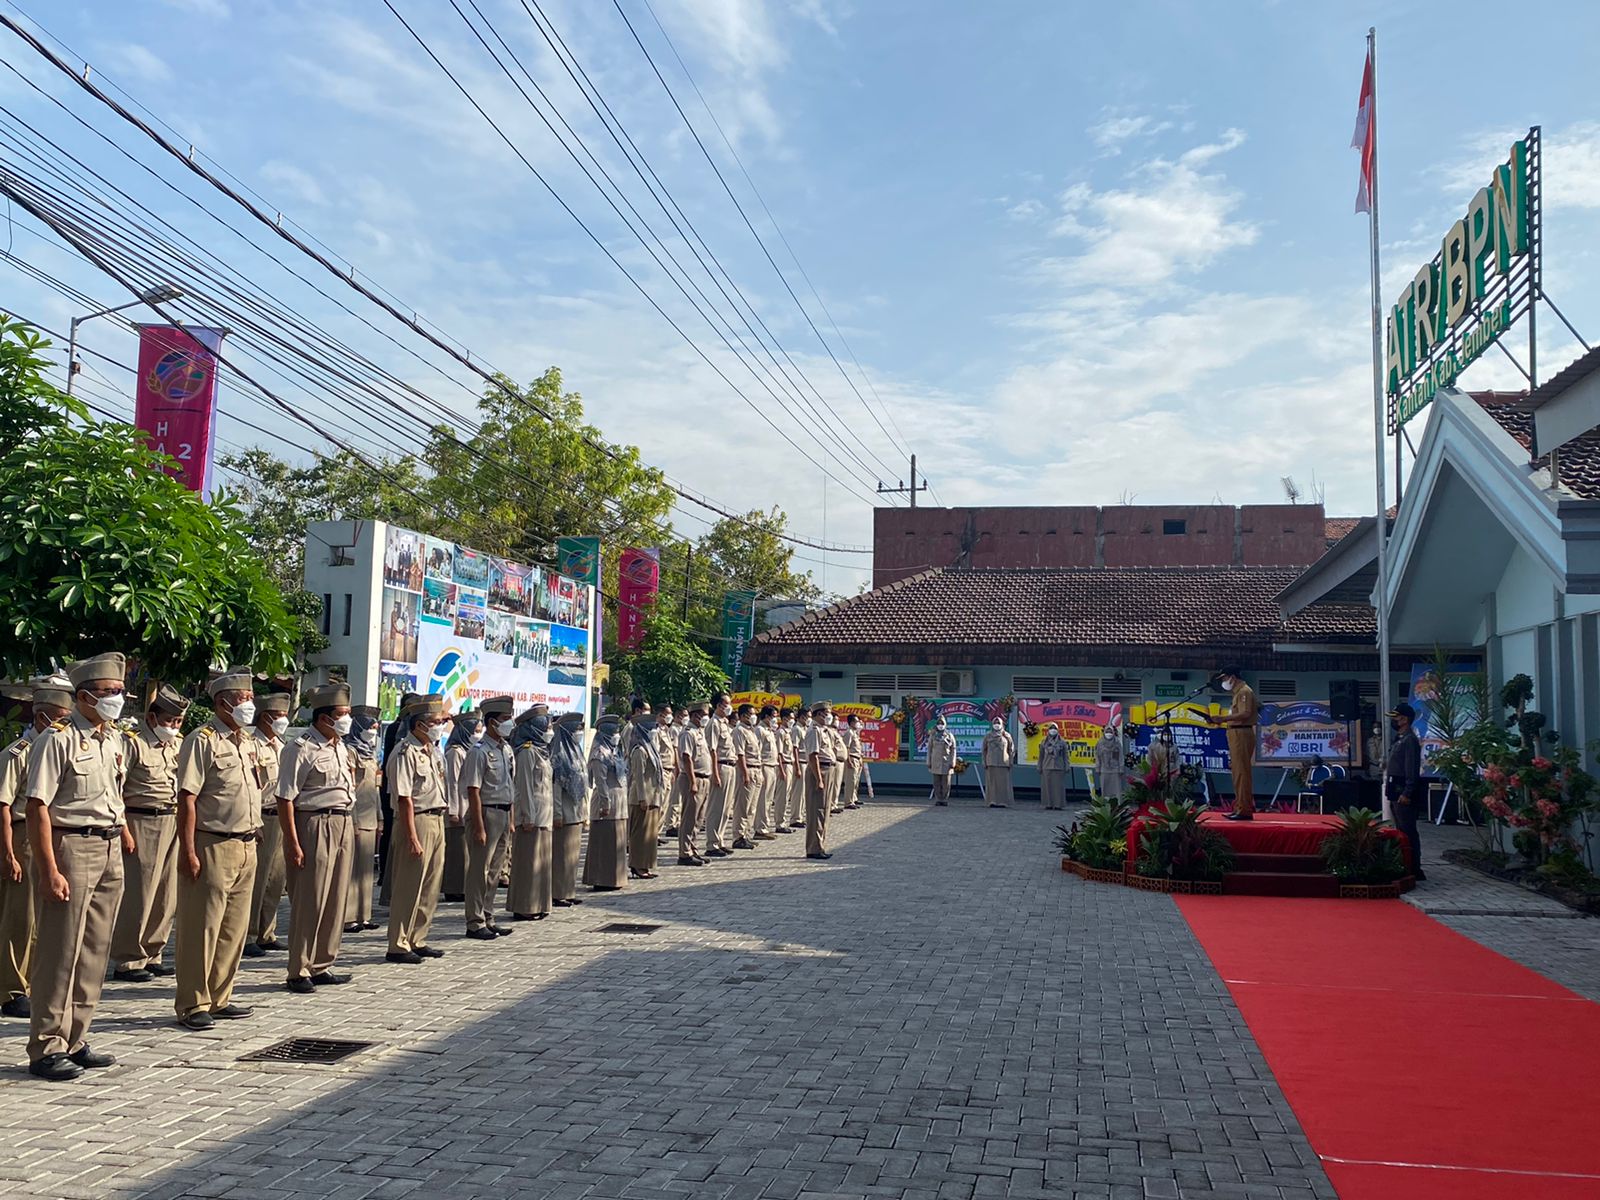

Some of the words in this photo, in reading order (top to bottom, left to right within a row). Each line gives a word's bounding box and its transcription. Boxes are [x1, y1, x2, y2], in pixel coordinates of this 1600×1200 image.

[1386, 140, 1526, 393] ATR/BPN
[1458, 300, 1511, 366] Jember
[733, 626, 744, 676] HANTARU
[458, 687, 480, 699] KANTOR
[528, 693, 547, 703] JEMBER
[1301, 743, 1323, 752] BRI
